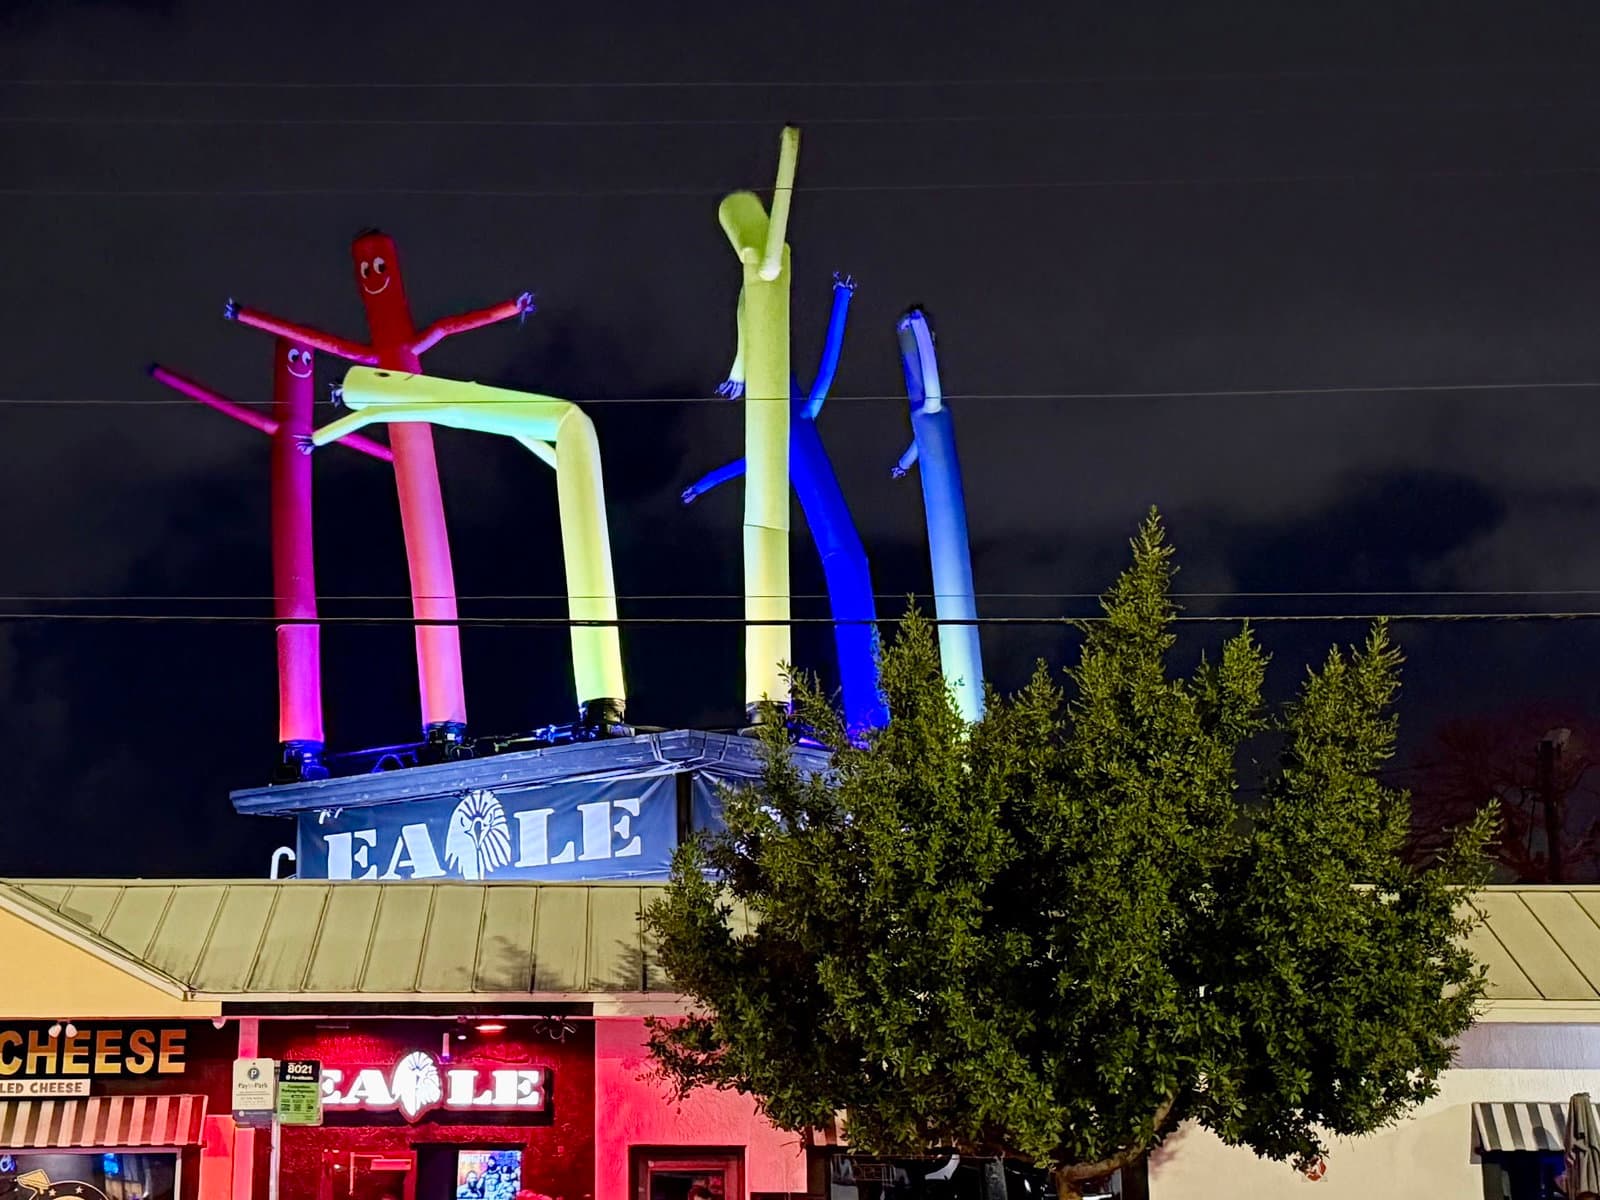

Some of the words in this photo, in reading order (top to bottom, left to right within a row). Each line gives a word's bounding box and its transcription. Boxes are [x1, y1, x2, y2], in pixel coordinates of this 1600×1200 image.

[0, 1029, 187, 1075] CHEESE
[287, 1064, 313, 1074] 8021
[30, 1082, 83, 1094] CHEESE
